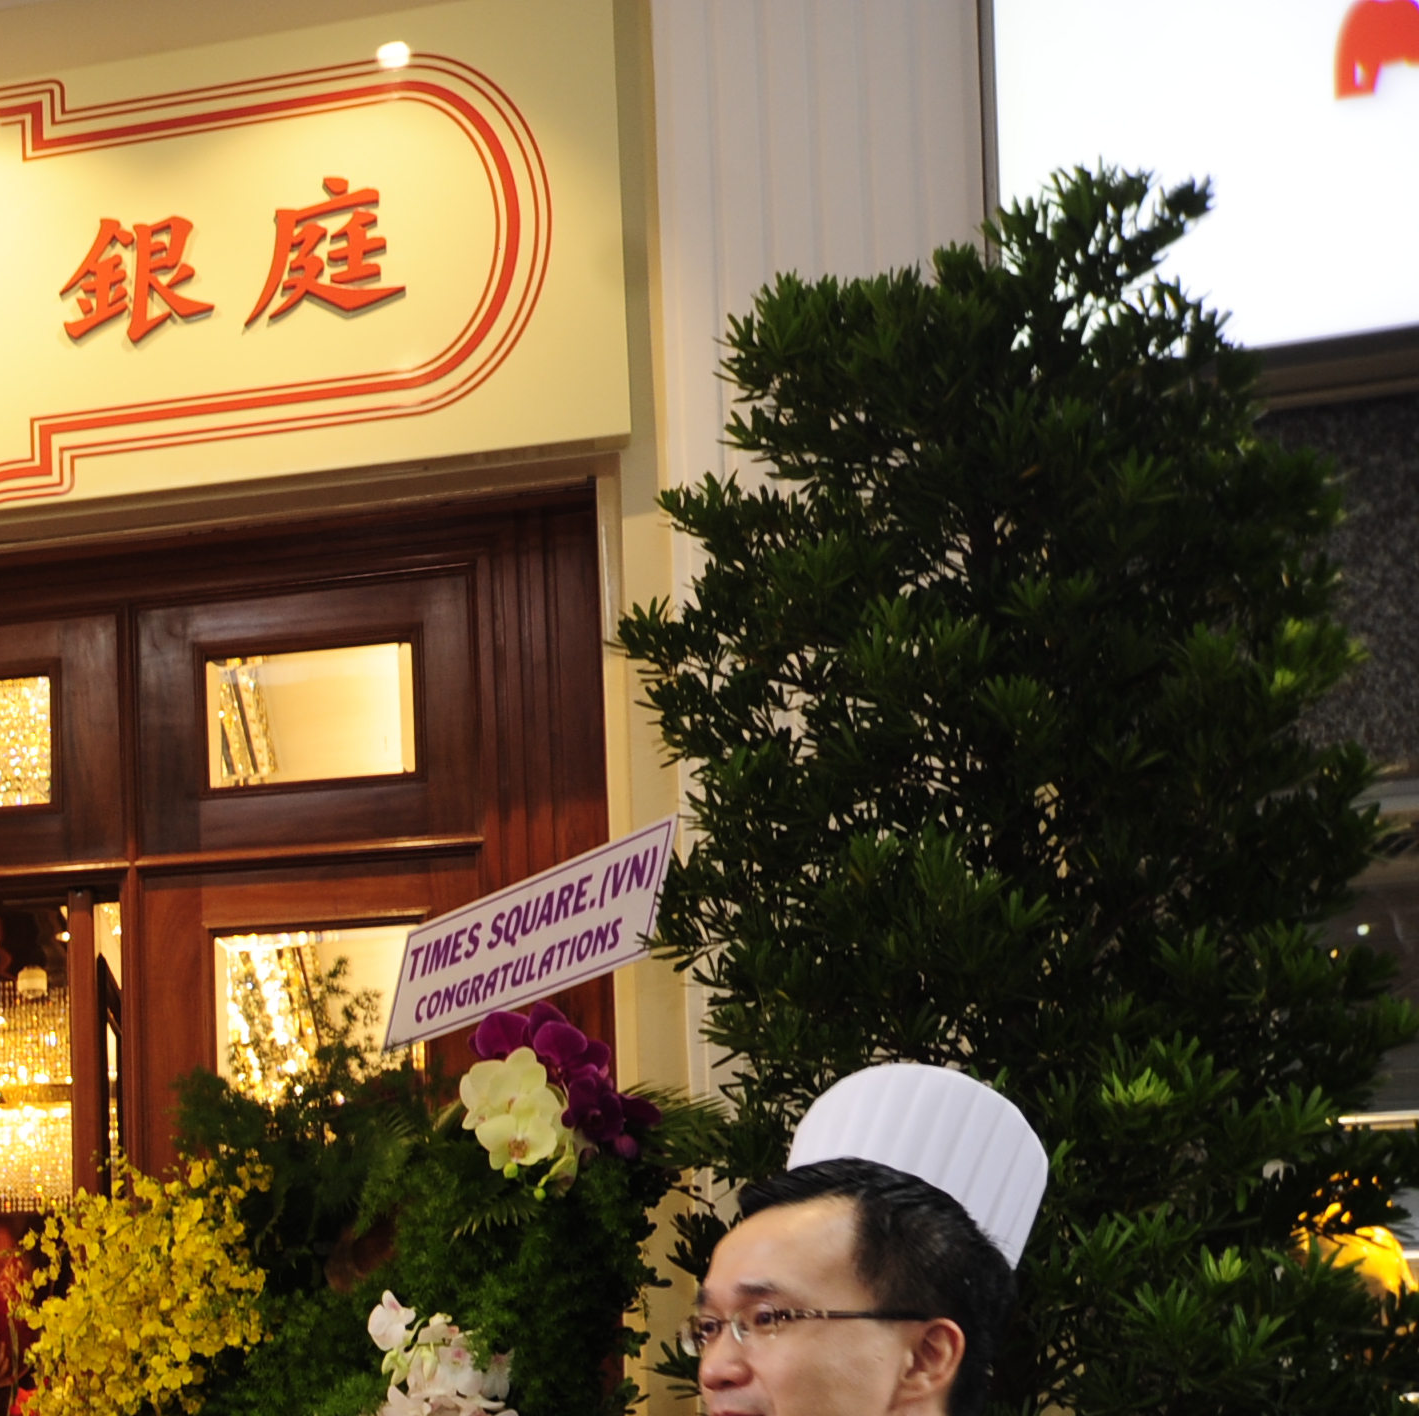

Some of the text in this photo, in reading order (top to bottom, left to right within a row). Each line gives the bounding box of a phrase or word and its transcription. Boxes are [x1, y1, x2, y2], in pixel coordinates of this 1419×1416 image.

[59, 176, 407, 344] 銀庭
[408, 922, 483, 982] TIMES
[413, 916, 623, 1024] CONGRATULATIONS
